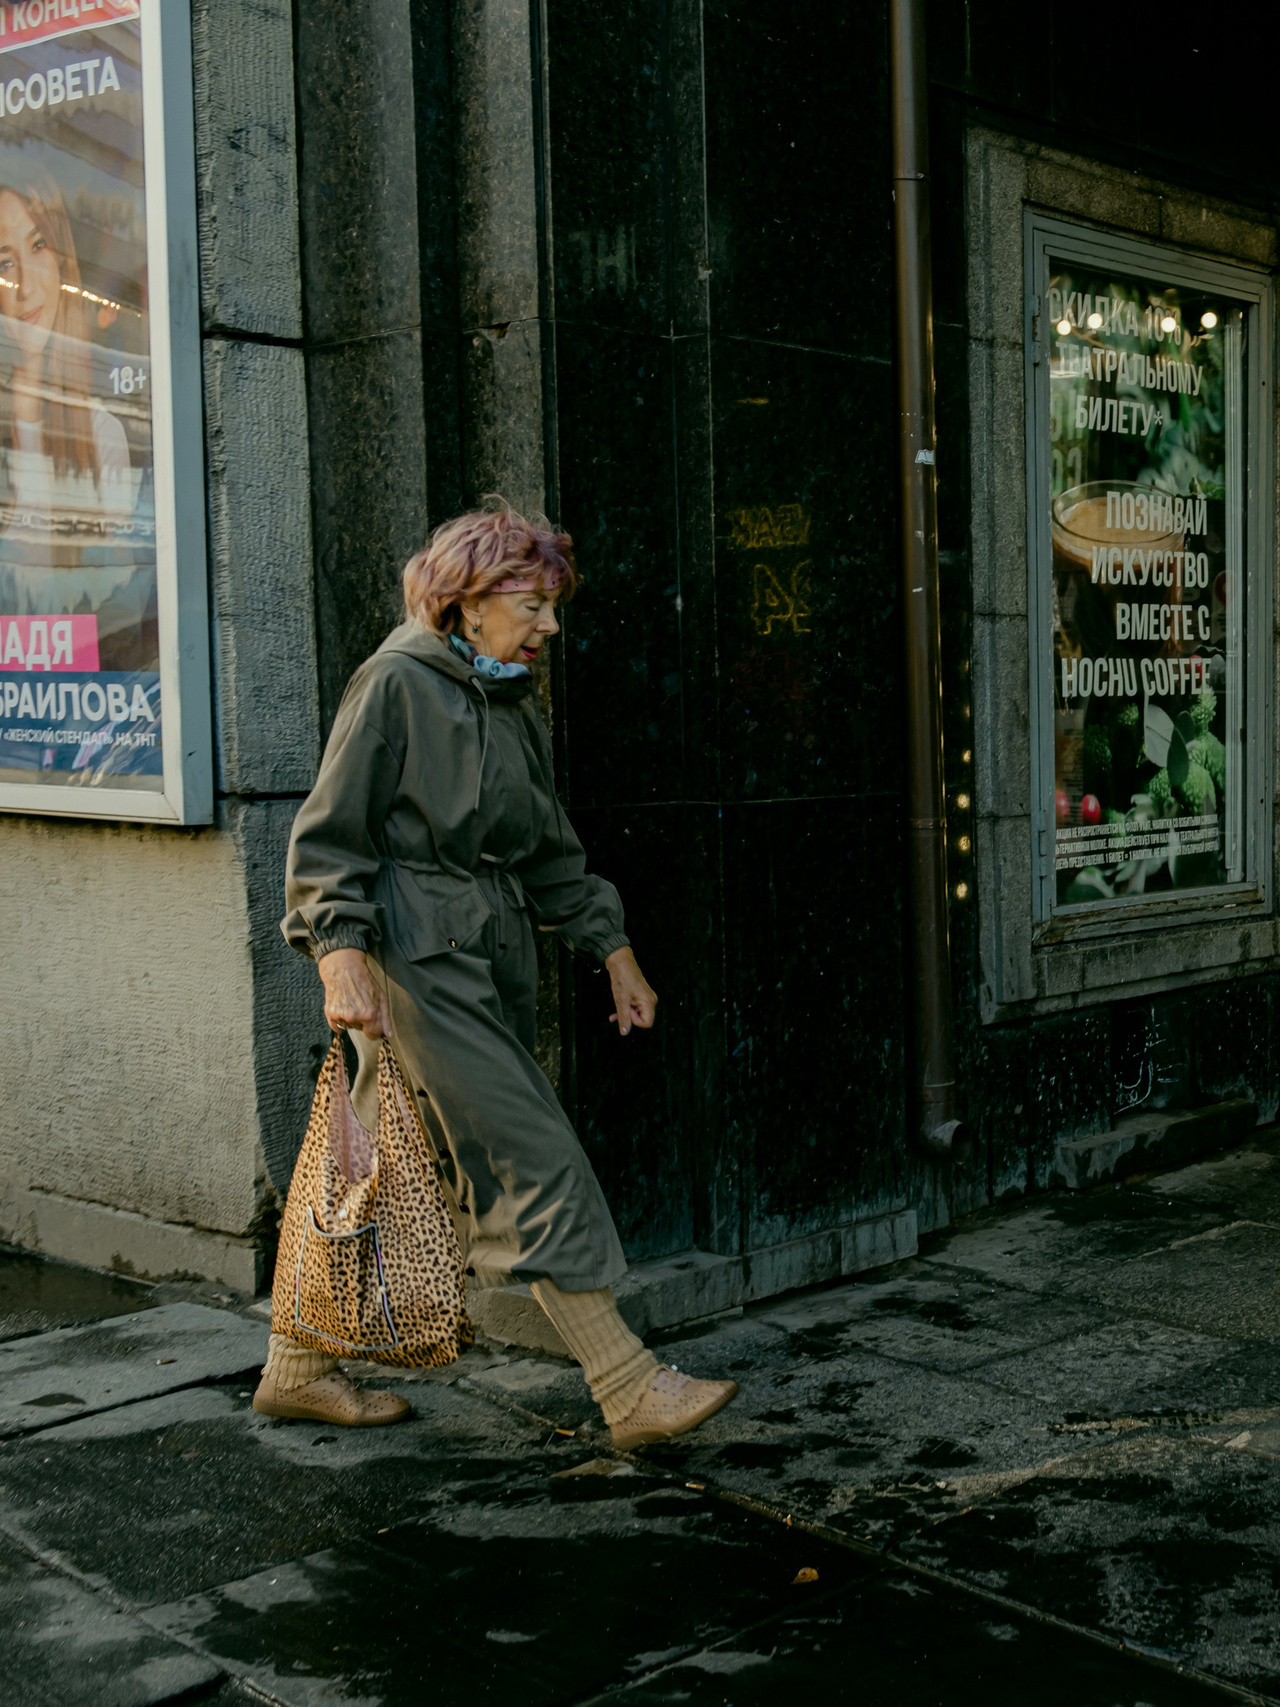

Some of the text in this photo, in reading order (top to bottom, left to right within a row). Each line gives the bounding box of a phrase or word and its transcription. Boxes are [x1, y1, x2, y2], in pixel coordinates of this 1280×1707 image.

[0, 56, 121, 117] СОВЕТА
[1049, 288, 1139, 336] СКИДКА
[109, 367, 146, 395] 18+
[1055, 341, 1202, 396] ТЕАТРАЛЬНОМУ
[1106, 490, 1207, 535] ПОЗНАВАЙ
[1091, 546, 1209, 588] ИСКУССТВО
[1116, 603, 1210, 641] ВМЕСТЕ С
[0, 620, 73, 671] АДЯ
[1061, 657, 1212, 697] HOCHU COFFEE
[0, 682, 155, 722] РАИЛОВА
[133, 733, 156, 747] ТНТ
